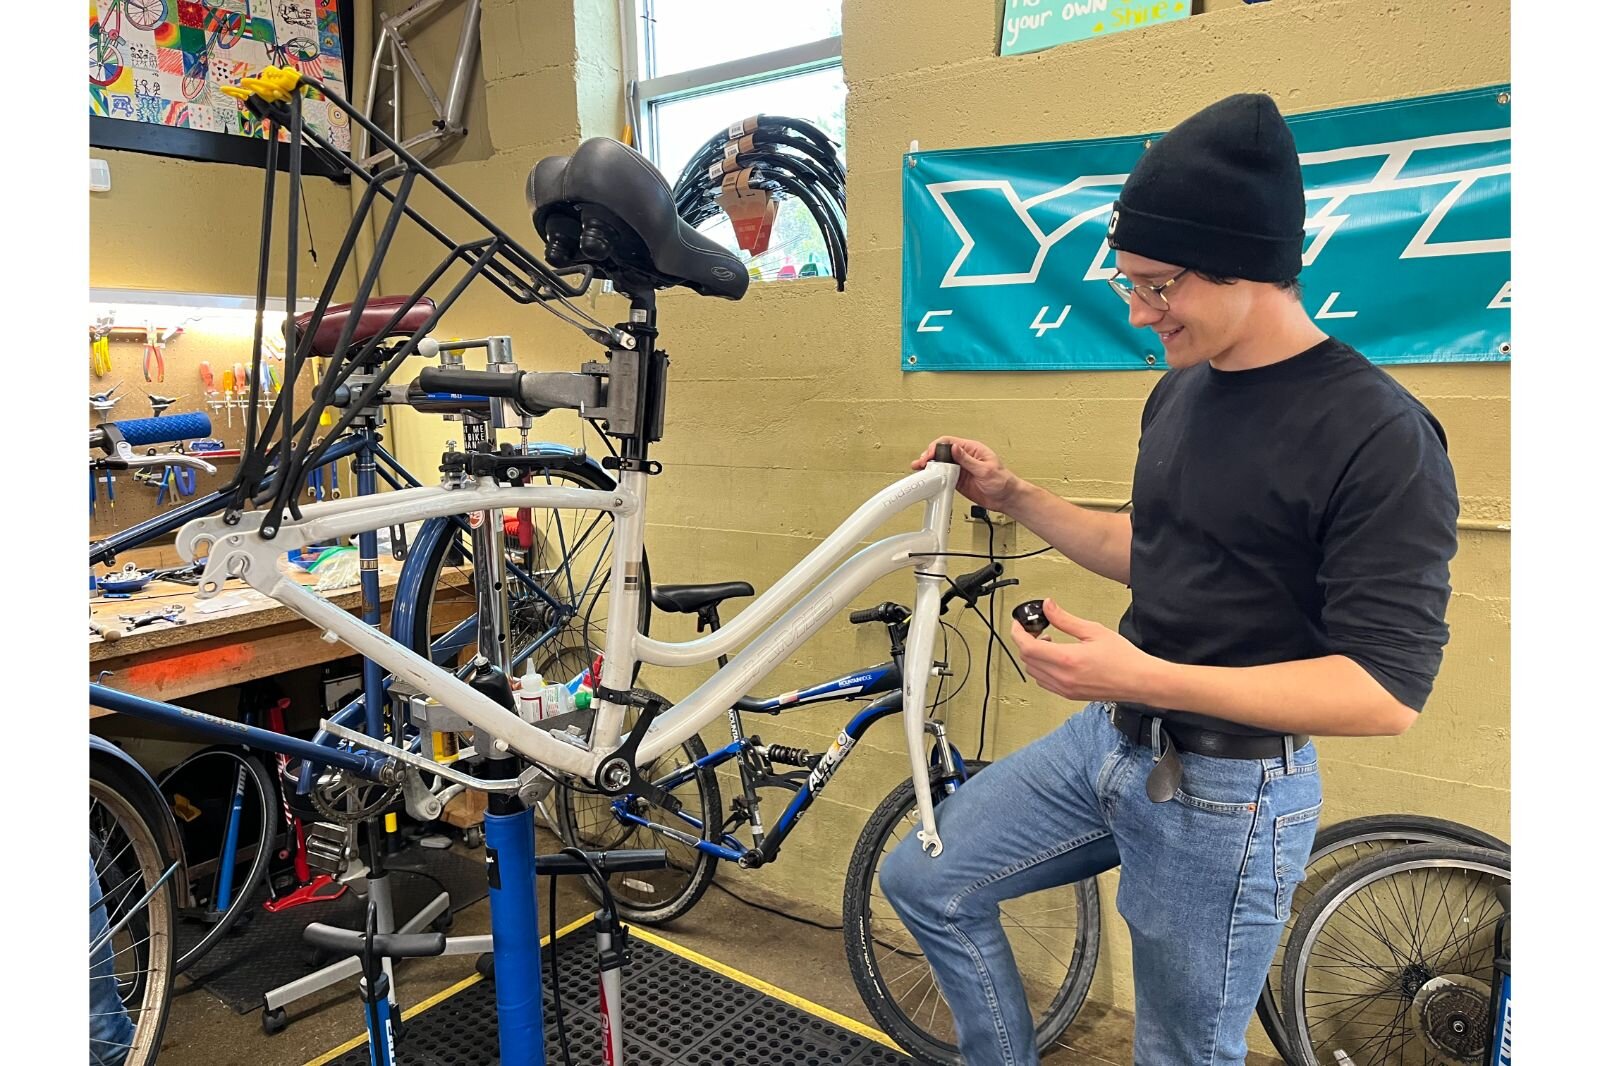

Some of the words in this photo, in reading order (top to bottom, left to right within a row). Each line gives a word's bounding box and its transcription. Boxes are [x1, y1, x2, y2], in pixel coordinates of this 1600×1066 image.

[1007, 12, 1053, 46] your
[1062, 0, 1107, 20] own
[1111, 1, 1168, 27] Shine
